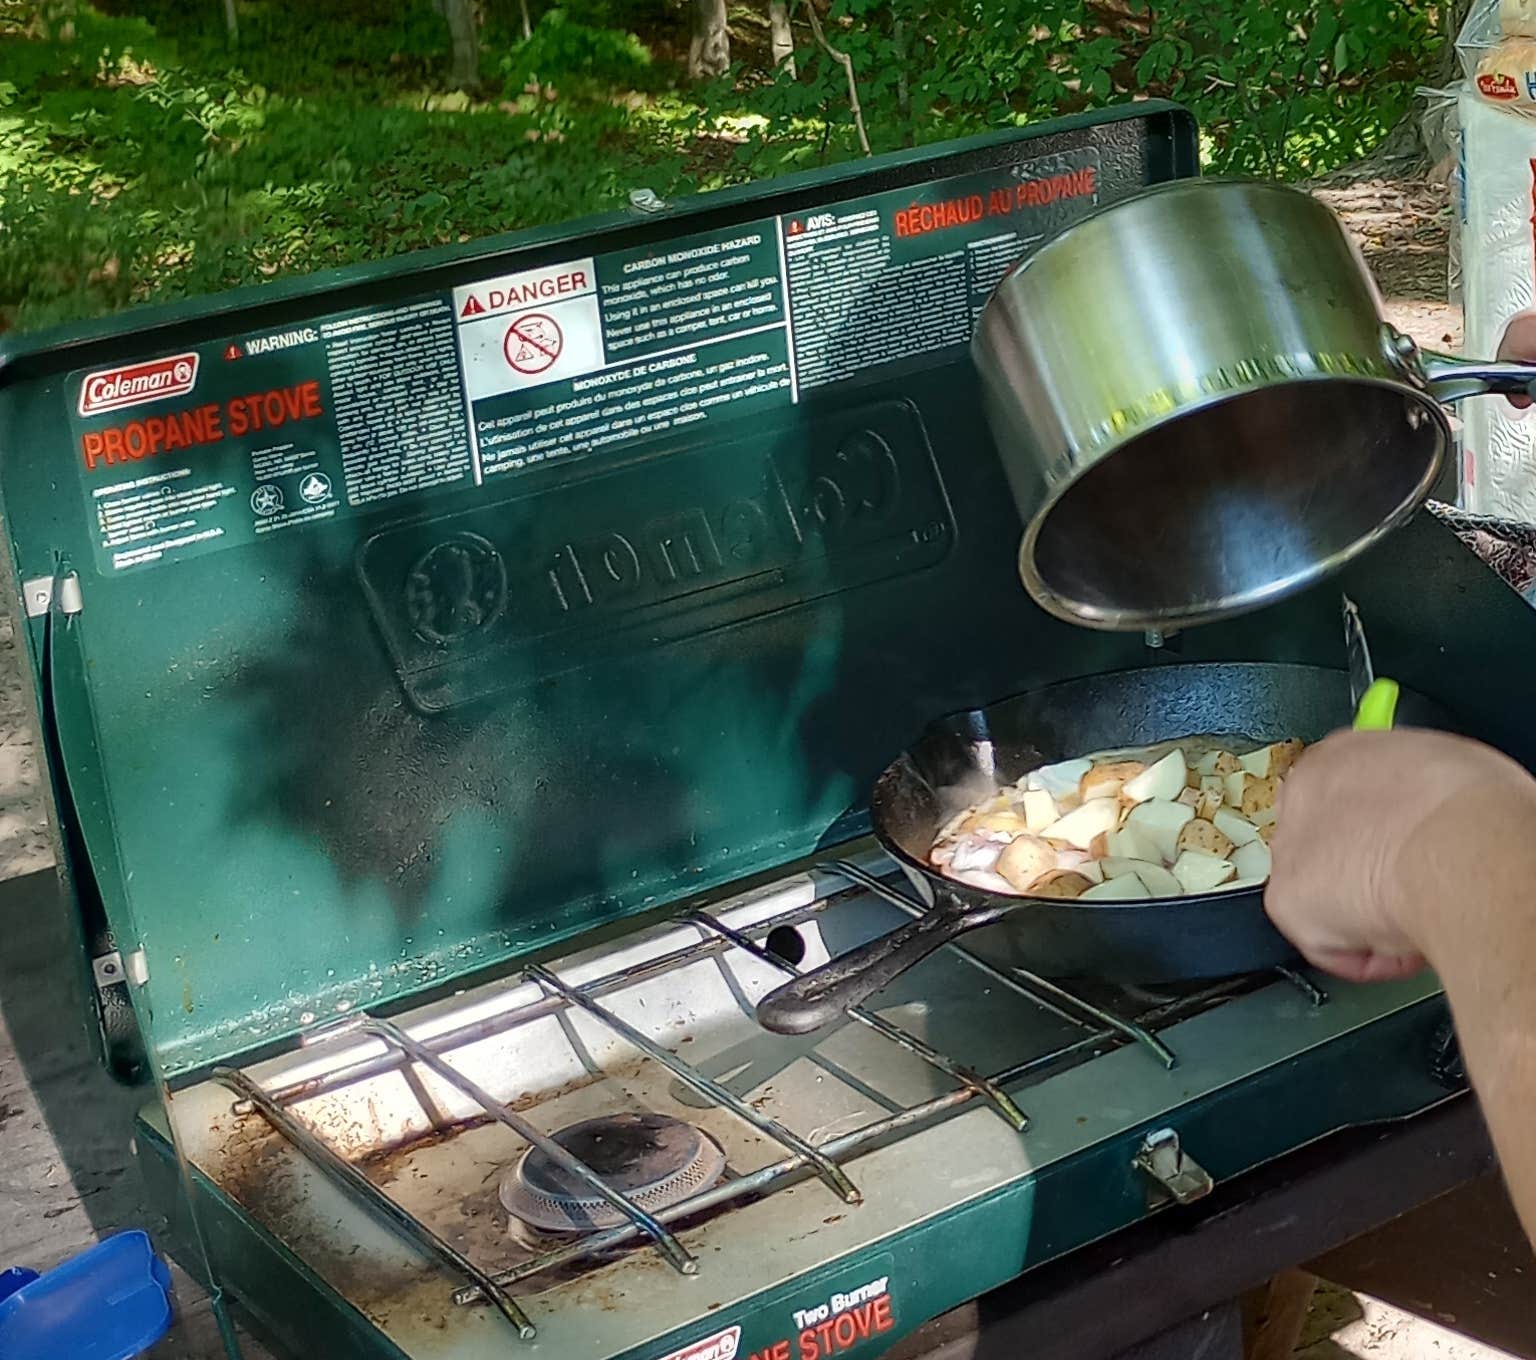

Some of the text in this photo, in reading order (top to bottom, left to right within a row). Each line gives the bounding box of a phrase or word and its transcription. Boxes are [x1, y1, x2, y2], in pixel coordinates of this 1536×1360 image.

[895, 195, 983, 237] RÉCHAUD
[989, 188, 1012, 215] AU
[1018, 167, 1096, 209] PROPANE
[807, 213, 835, 231] AVIS:
[602, 254, 750, 294] This appliance can produce carbon
[623, 235, 761, 274] CARBON MONOXIDE HAZARD
[489, 272, 586, 309] DANGER
[246, 328, 318, 355] WARNING:
[88, 368, 172, 402] Coleman
[574, 353, 698, 392] MONOXYDE DE CARBONE
[82, 380, 322, 469] PROPANE STOVE
[792, 1276, 889, 1329] Two Burner
